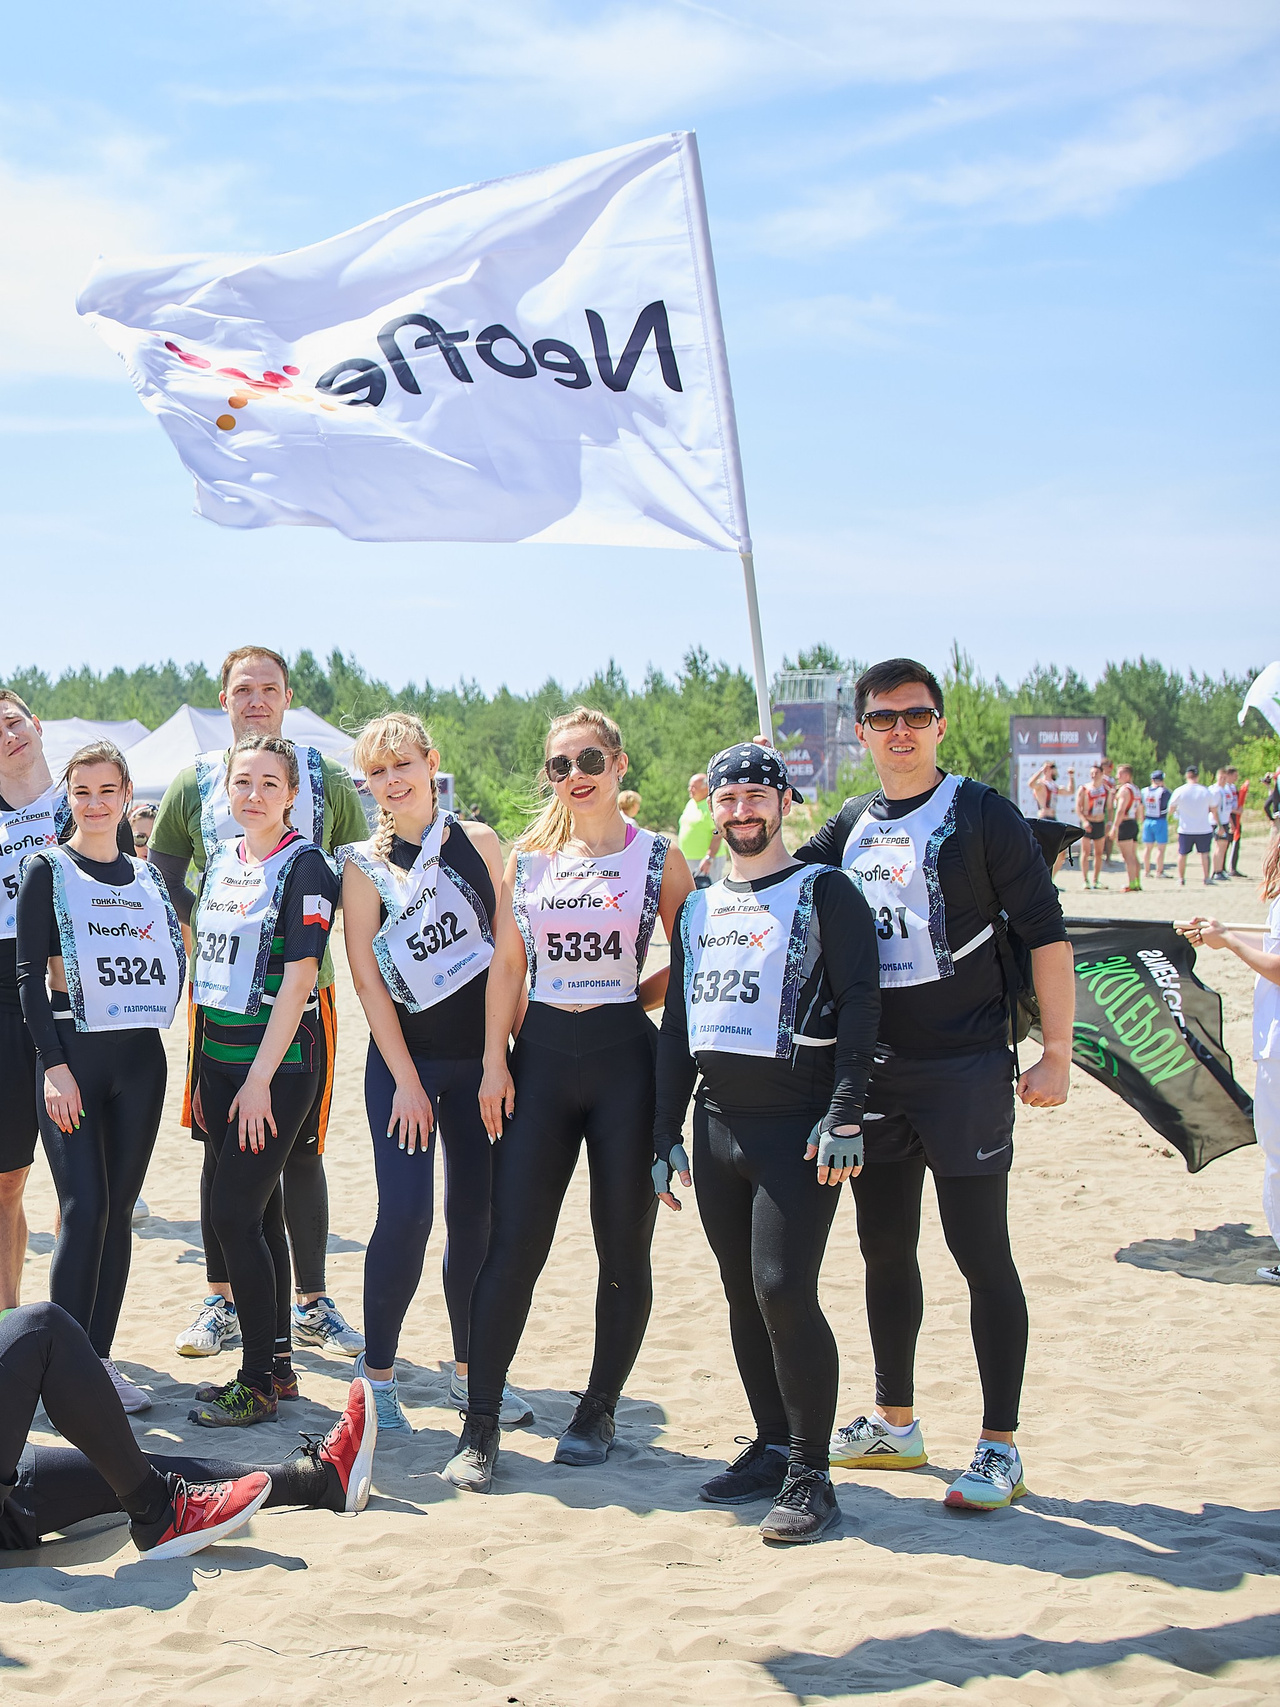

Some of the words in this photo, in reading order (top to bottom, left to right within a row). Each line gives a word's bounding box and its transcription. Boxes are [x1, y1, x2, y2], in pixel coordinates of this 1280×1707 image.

[21, 811, 51, 821] ГЕРОЕВ
[880, 836, 910, 845] ГЕРОЕВ
[422, 855, 440, 869] РОЕВ
[860, 860, 912, 887] eoflex
[204, 898, 258, 920] Neoflex
[540, 890, 628, 912] Neoflex
[713, 905, 736, 915] ГОНКА
[737, 904, 770, 912] ГЕРОЕВ
[87, 920, 156, 942] Neoflex
[870, 906, 910, 940] 31
[546, 930, 623, 962] 5334
[697, 926, 774, 952] Neoflex
[96, 956, 167, 987] 5324
[878, 961, 914, 972] РОМБАНК
[567, 979, 622, 989] ГАЗПРОМБАНК
[691, 969, 761, 1005] 5325
[123, 1004, 168, 1013] ГАЗПРОМБАНК
[699, 1024, 753, 1036] ГАЗПРОМБАНК
